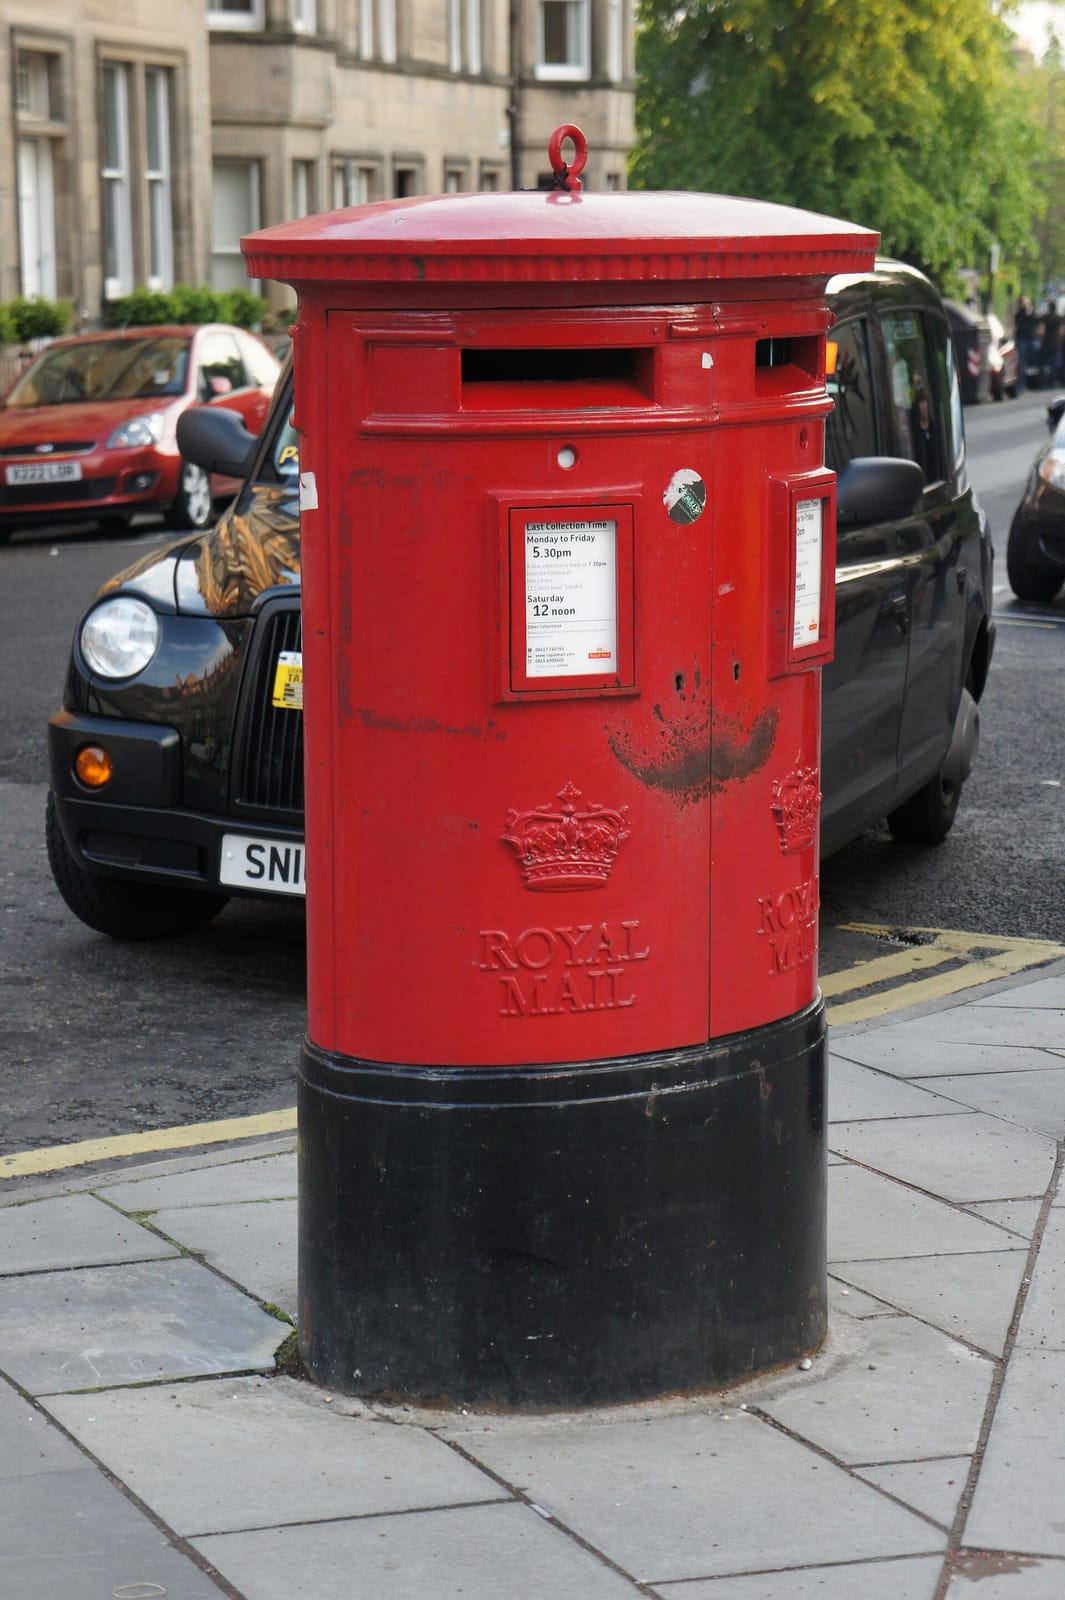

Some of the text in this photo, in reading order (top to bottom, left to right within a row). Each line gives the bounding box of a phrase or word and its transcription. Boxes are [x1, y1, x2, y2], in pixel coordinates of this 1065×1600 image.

[526, 521, 608, 531] Last Collection Time
[526, 533, 596, 545] Monday to Friday
[532, 546, 572, 560] 5.30pm
[527, 594, 565, 603] Saturday
[533, 604, 576, 617] 12 noon
[287, 673, 304, 684] TA
[478, 919, 651, 971] ROYAL
[499, 967, 636, 1017] MAIL
